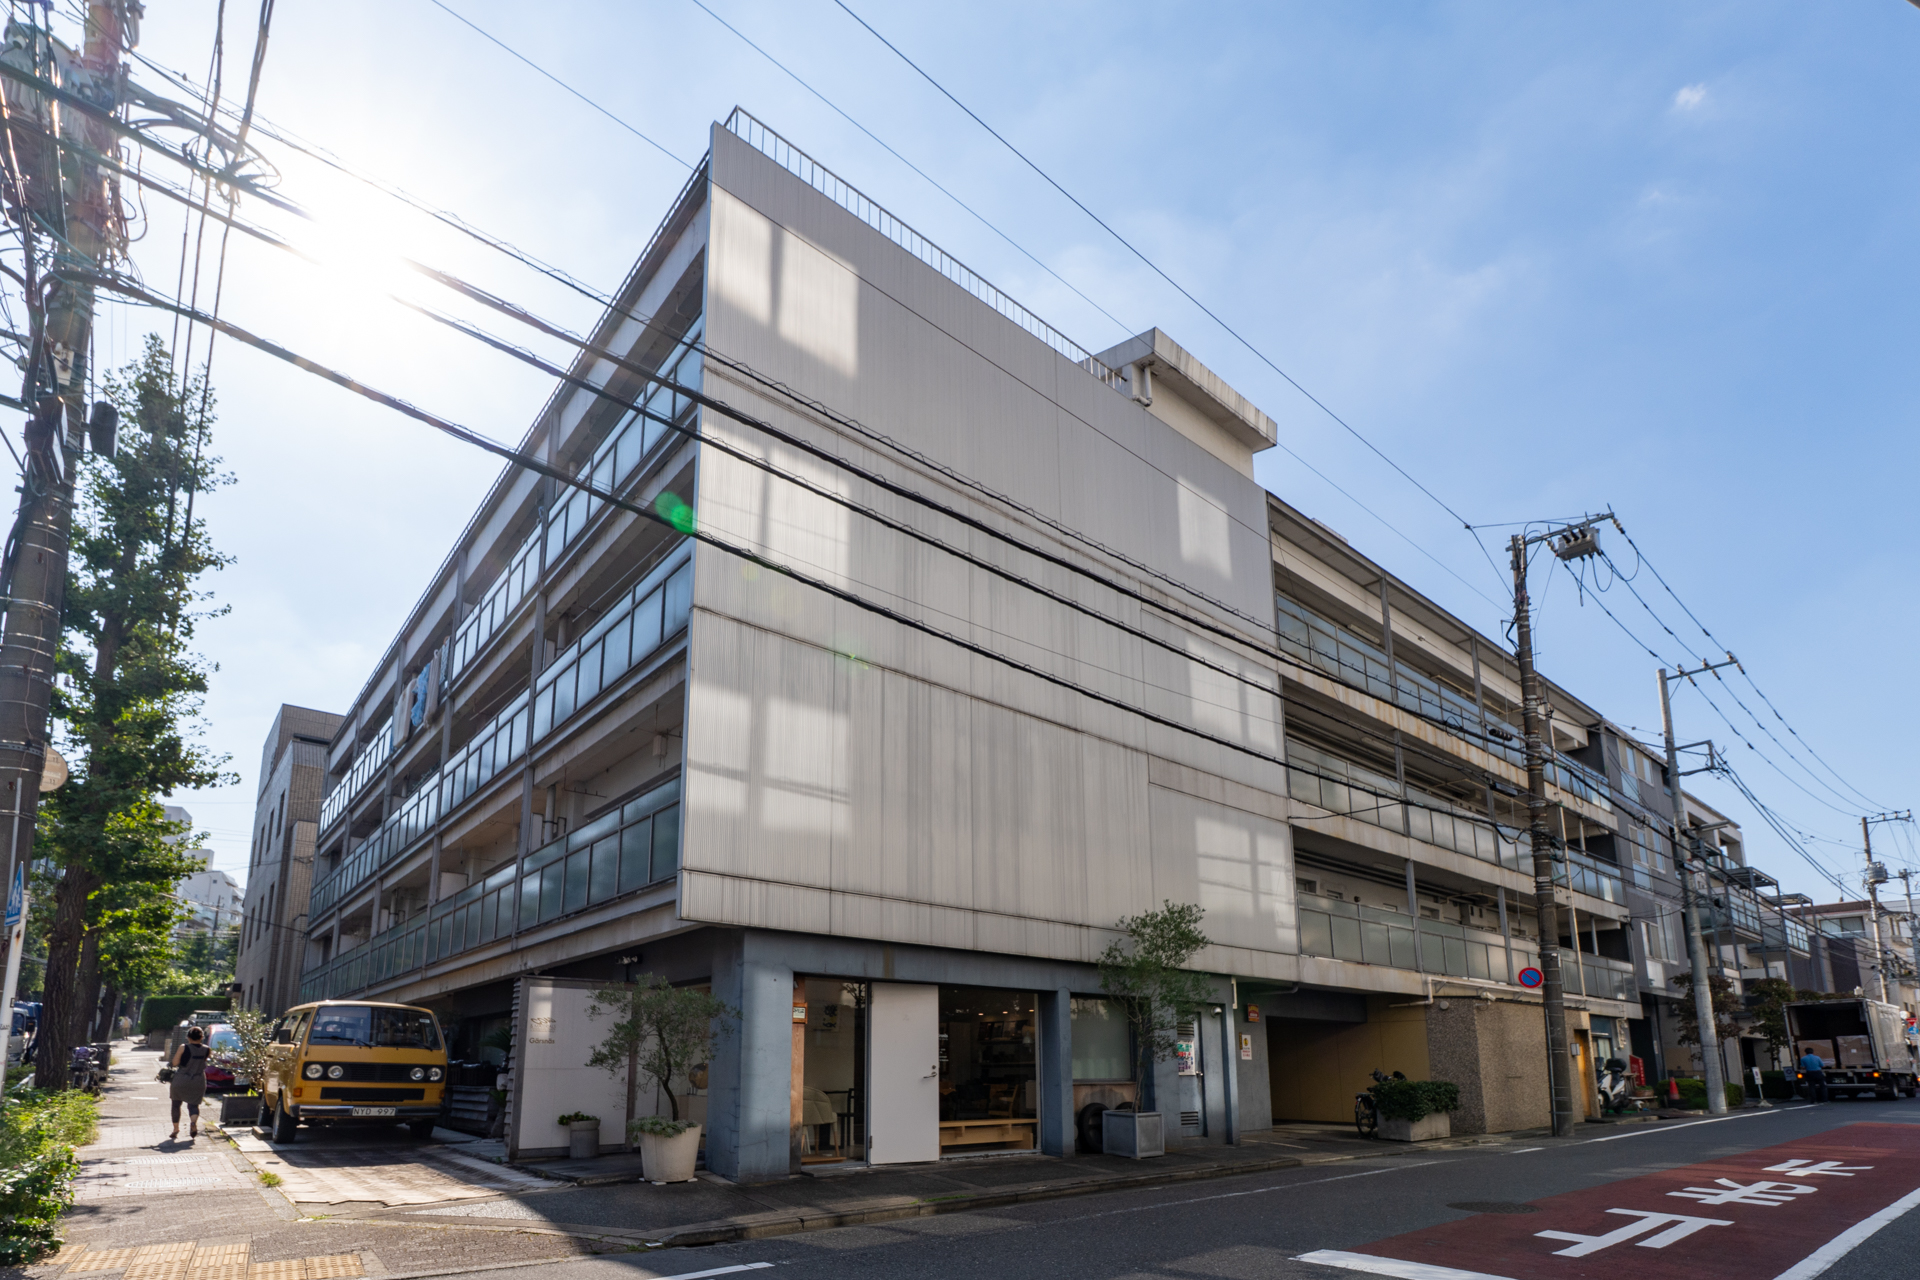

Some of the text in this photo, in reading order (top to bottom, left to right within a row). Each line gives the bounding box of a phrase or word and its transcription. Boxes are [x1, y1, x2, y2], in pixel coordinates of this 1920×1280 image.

[353, 1107, 395, 1115] NYD 997
[1533, 1159, 1874, 1257] 止まれ
